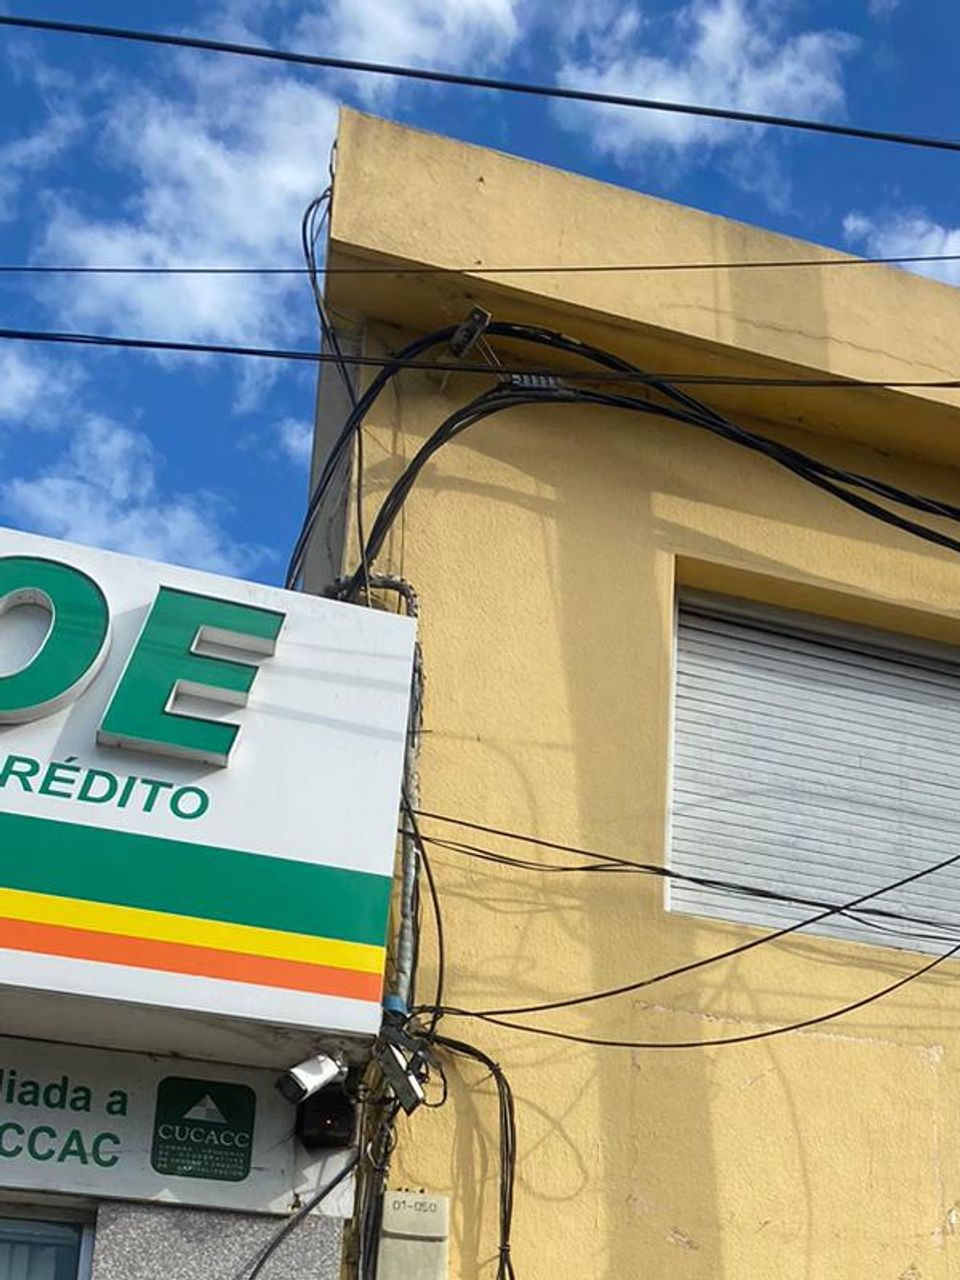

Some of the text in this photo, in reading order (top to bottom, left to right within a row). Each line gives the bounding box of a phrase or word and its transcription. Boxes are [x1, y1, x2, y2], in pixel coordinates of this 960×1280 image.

[0, 755, 210, 820] RÉDITO
[106, 1089, 128, 1116] a
[0, 1122, 121, 1168] CCAC
[158, 1124, 250, 1148] CUCACC
